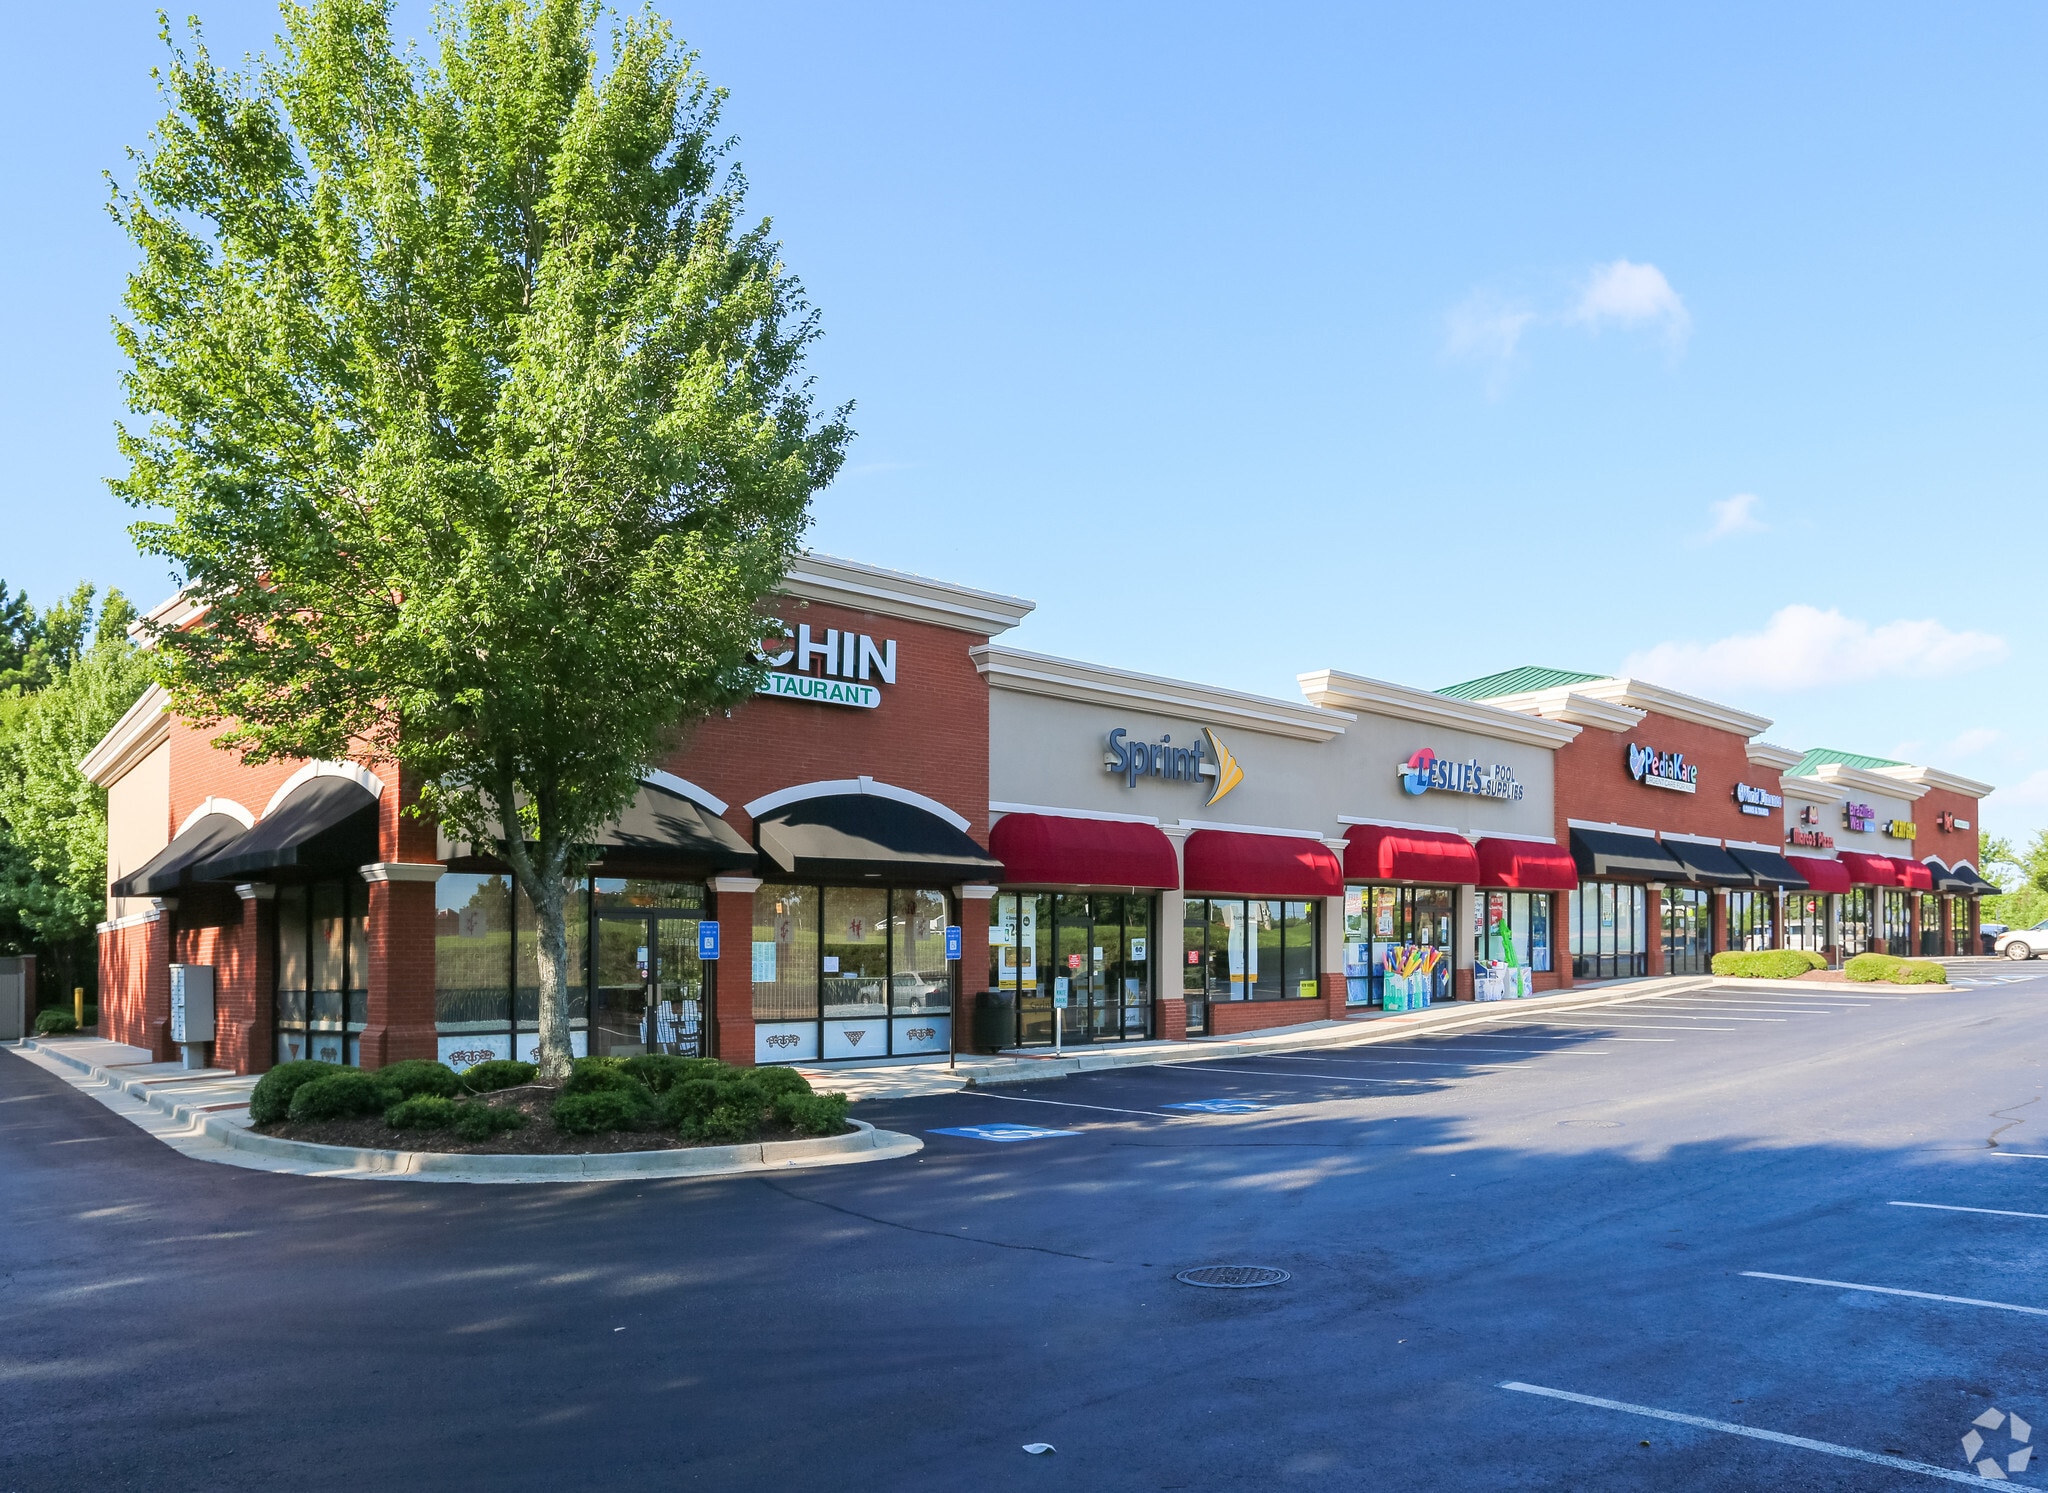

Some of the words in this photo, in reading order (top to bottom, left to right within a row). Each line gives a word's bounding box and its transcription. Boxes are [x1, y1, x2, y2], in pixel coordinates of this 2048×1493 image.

[760, 673, 873, 705] STAURANT
[1109, 727, 1205, 788] Sprint
[1494, 764, 1515, 783] POOL
[1645, 745, 1698, 783] PediaKare
[1417, 756, 1482, 795] LESLIE'S
[1485, 780, 1524, 801] SUPPLIES
[1850, 816, 1864, 831] Wax
